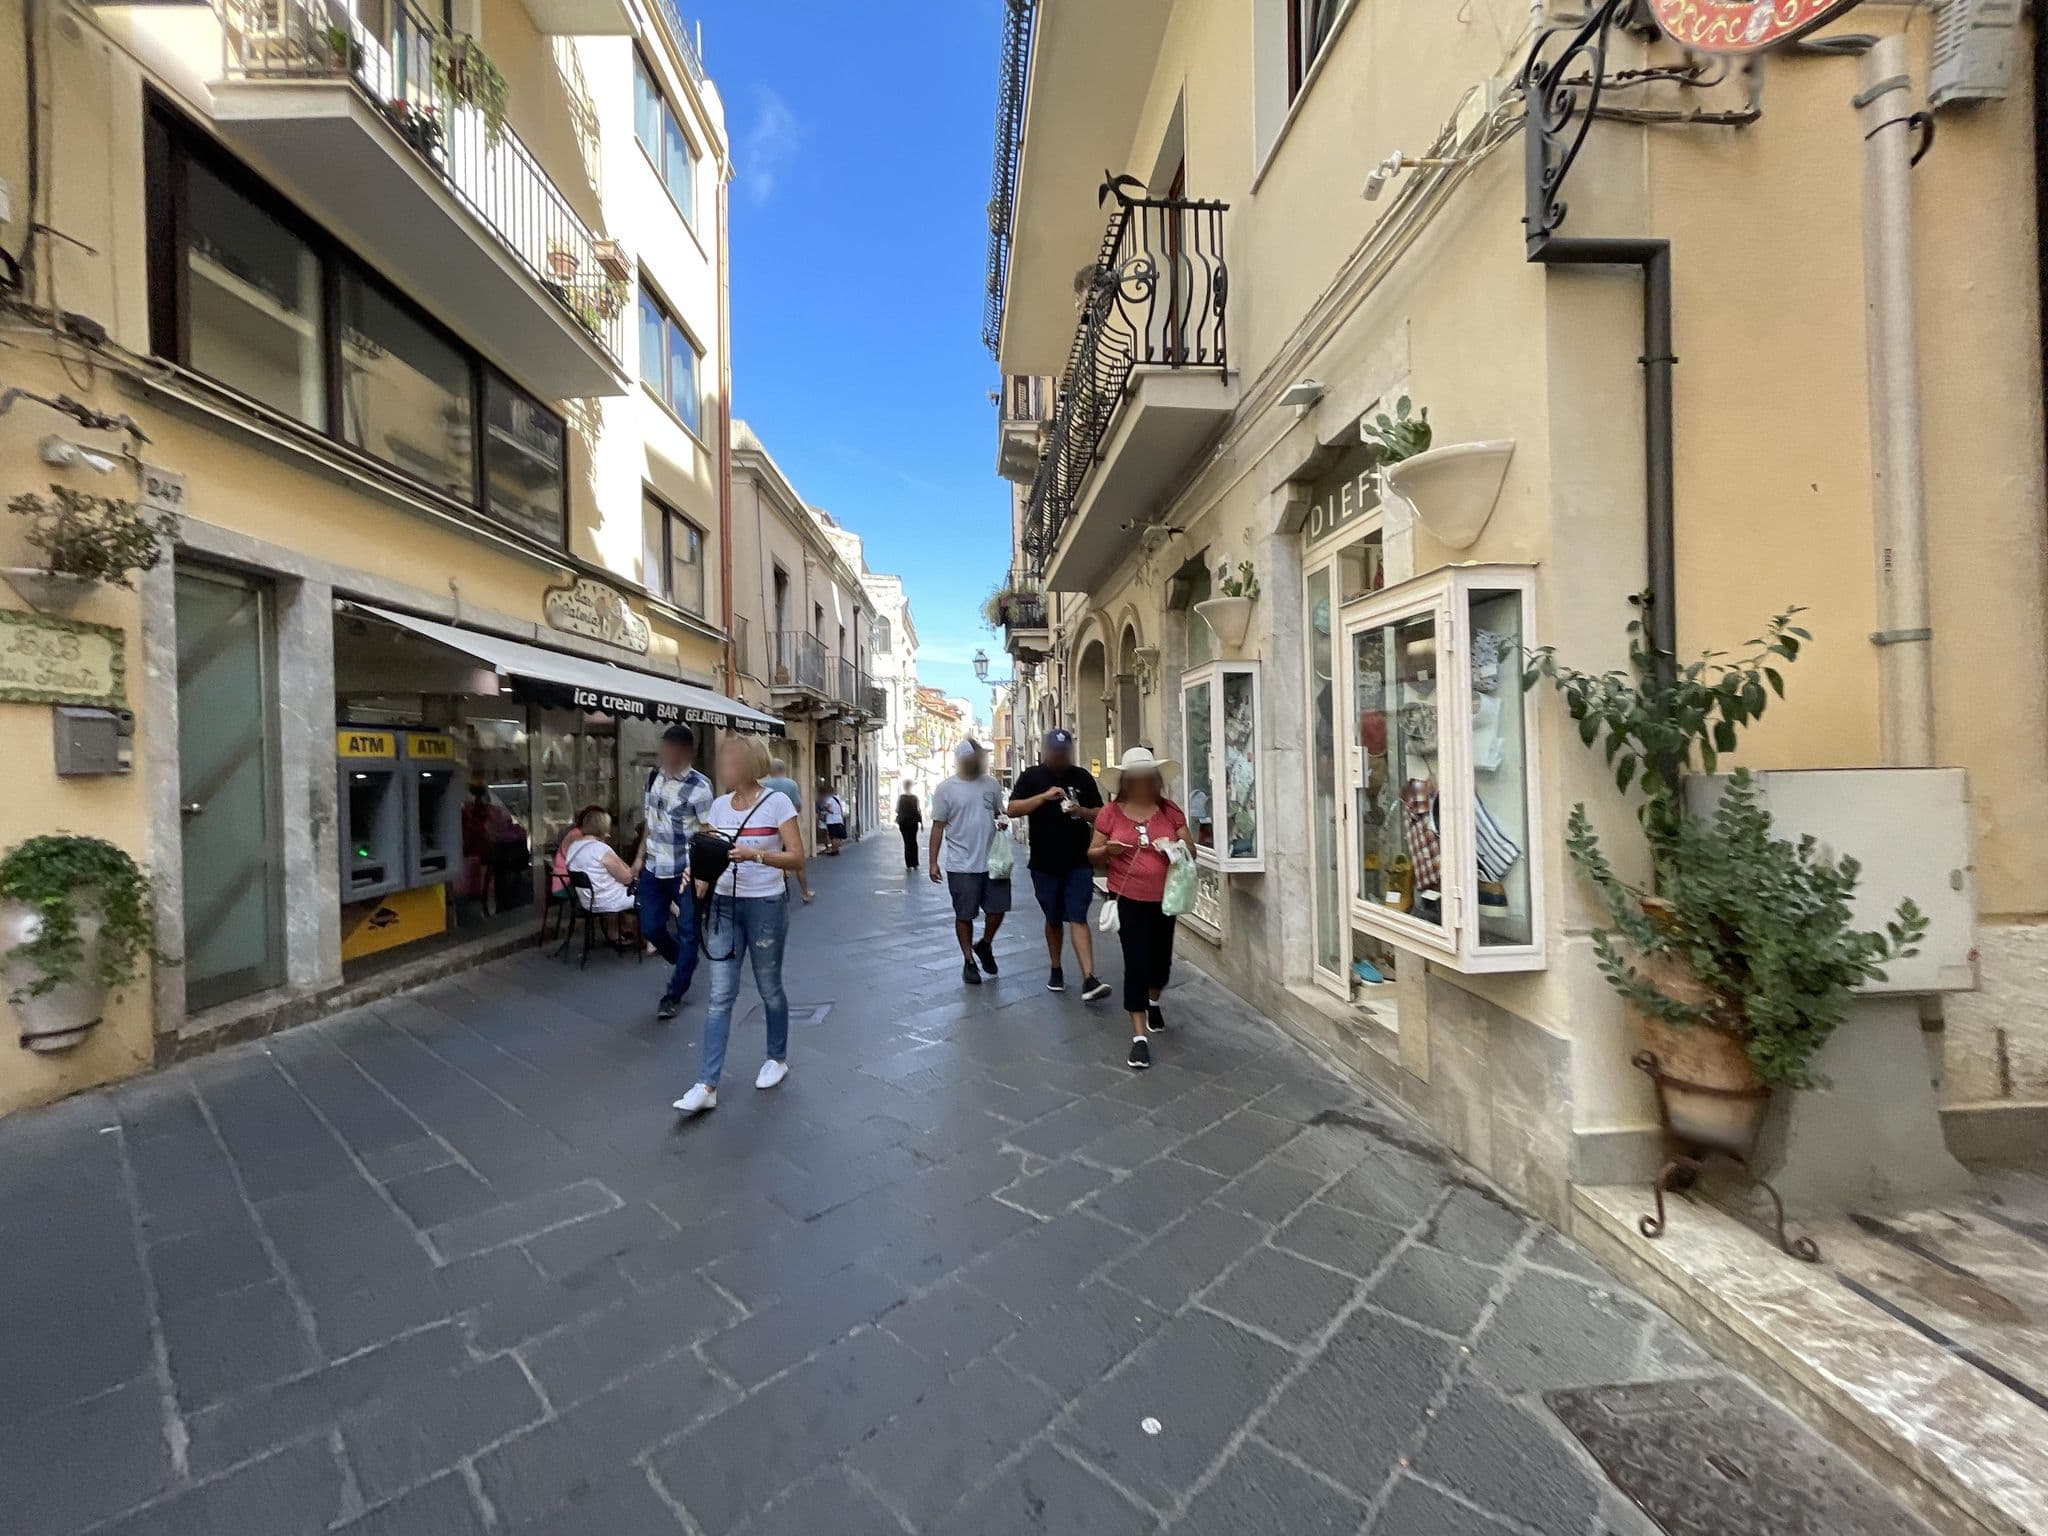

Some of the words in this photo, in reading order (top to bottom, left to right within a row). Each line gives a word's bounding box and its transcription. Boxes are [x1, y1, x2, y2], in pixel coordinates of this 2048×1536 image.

[574, 688, 597, 706] ice
[601, 695, 644, 714] cream
[657, 703, 678, 719] BAR
[685, 708, 728, 726] GELATERIA
[349, 736, 384, 753] ATM
[417, 739, 447, 755] ATM
